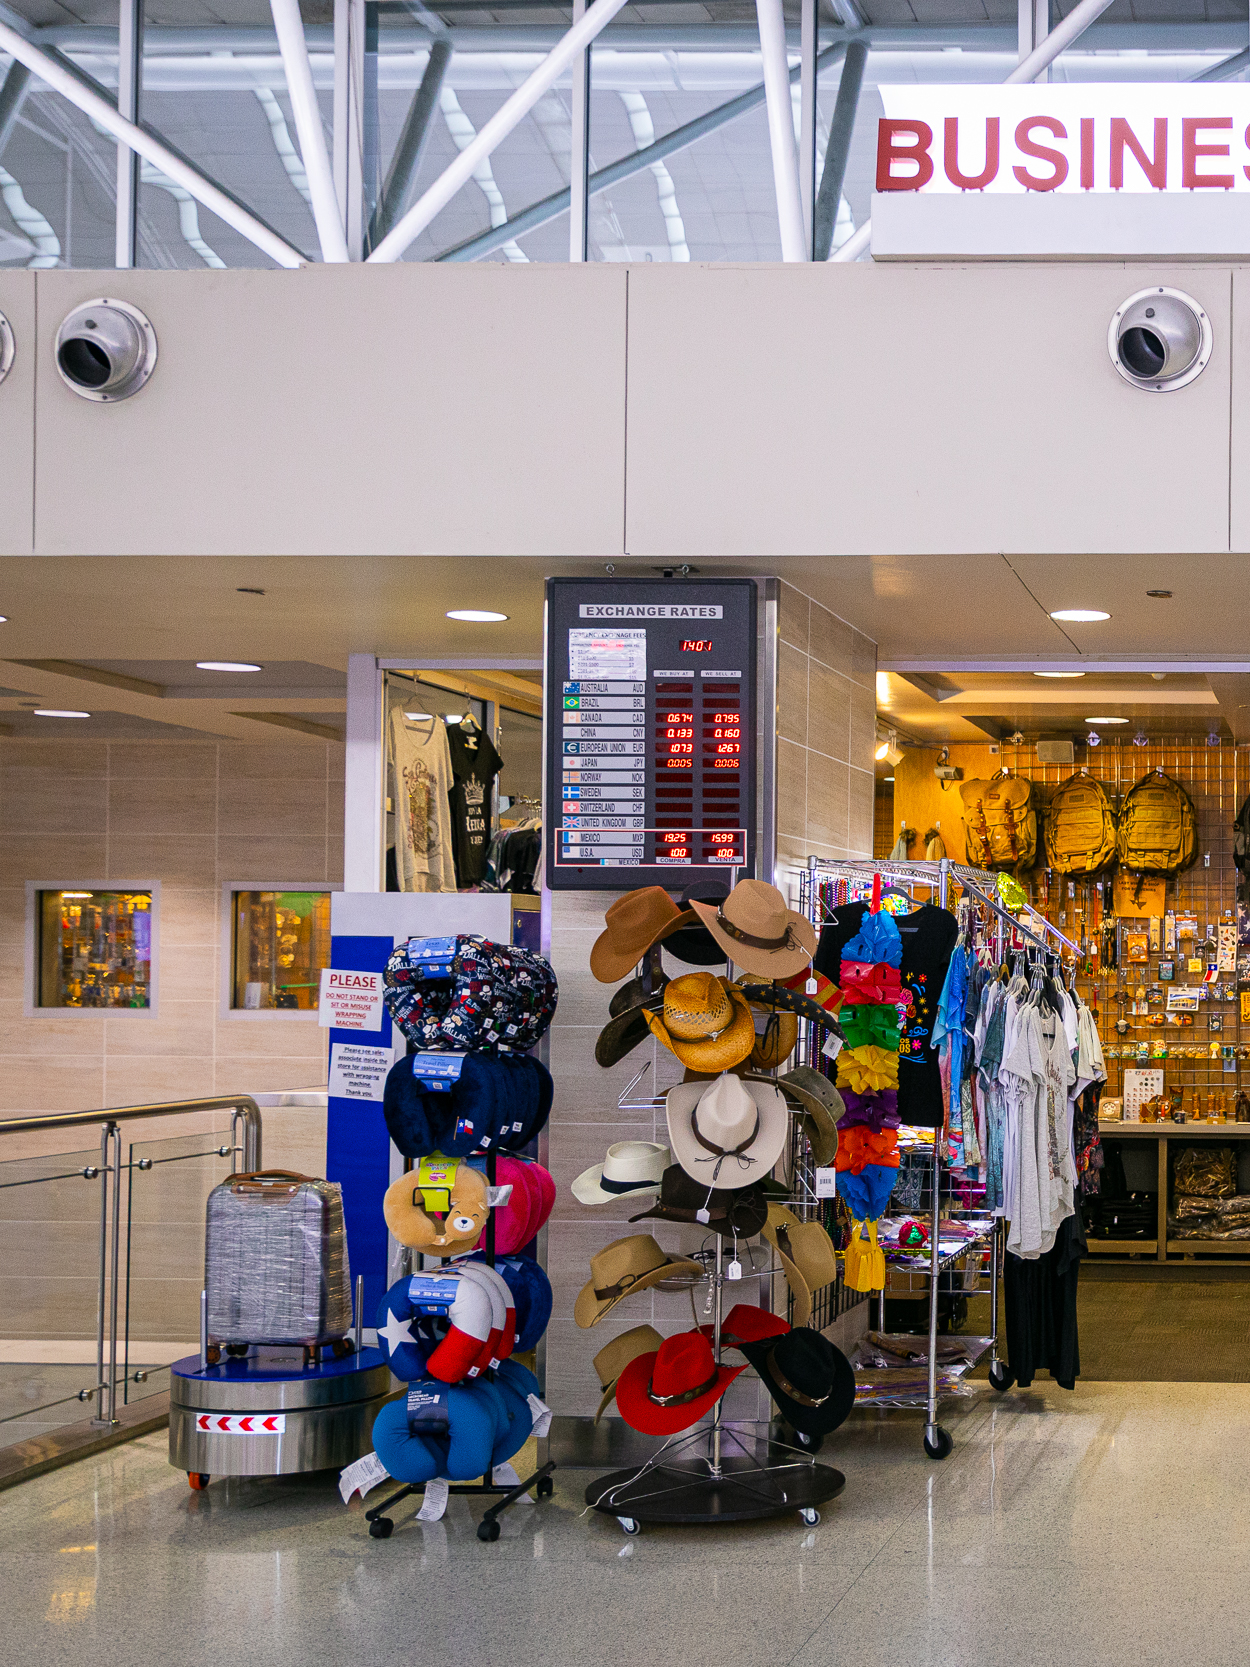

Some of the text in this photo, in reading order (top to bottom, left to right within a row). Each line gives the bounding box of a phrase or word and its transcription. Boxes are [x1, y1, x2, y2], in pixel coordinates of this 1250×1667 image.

[586, 606, 717, 617] EXCHANGE RATES
[580, 683, 608, 693] AUSTRALIA
[633, 683, 643, 692] AUD
[581, 698, 599, 708] BRAZIL
[633, 698, 643, 708] BRL
[580, 713, 602, 722] CANADA
[633, 713, 643, 722] CAD
[580, 728, 596, 737] CHINA
[633, 728, 643, 738] CNY
[580, 743, 626, 752] EUROPEAN UNION
[633, 743, 643, 752] EUR
[580, 758, 598, 767] JAPAN
[633, 758, 643, 767] JPY
[580, 773, 602, 782] NORWAY
[631, 773, 643, 782] NOK
[580, 788, 602, 797] SWEDEN
[632, 788, 643, 797] SEK
[580, 803, 615, 812] SWITZERLAND
[632, 803, 643, 812] CHF
[581, 818, 627, 827] UNITED KINGDOM
[632, 818, 643, 827] GBP
[580, 833, 600, 842] MEXICO
[632, 833, 643, 842] MXP
[631, 848, 643, 857] USD
[329, 973, 377, 988] PLEASE
[334, 1011, 367, 1019] WRAPPING
[335, 1020, 365, 1028] MACHINE.
[343, 1046, 361, 1054] Please
[361, 1064, 387, 1072] assistance
[356, 1073, 380, 1081] wrapping
